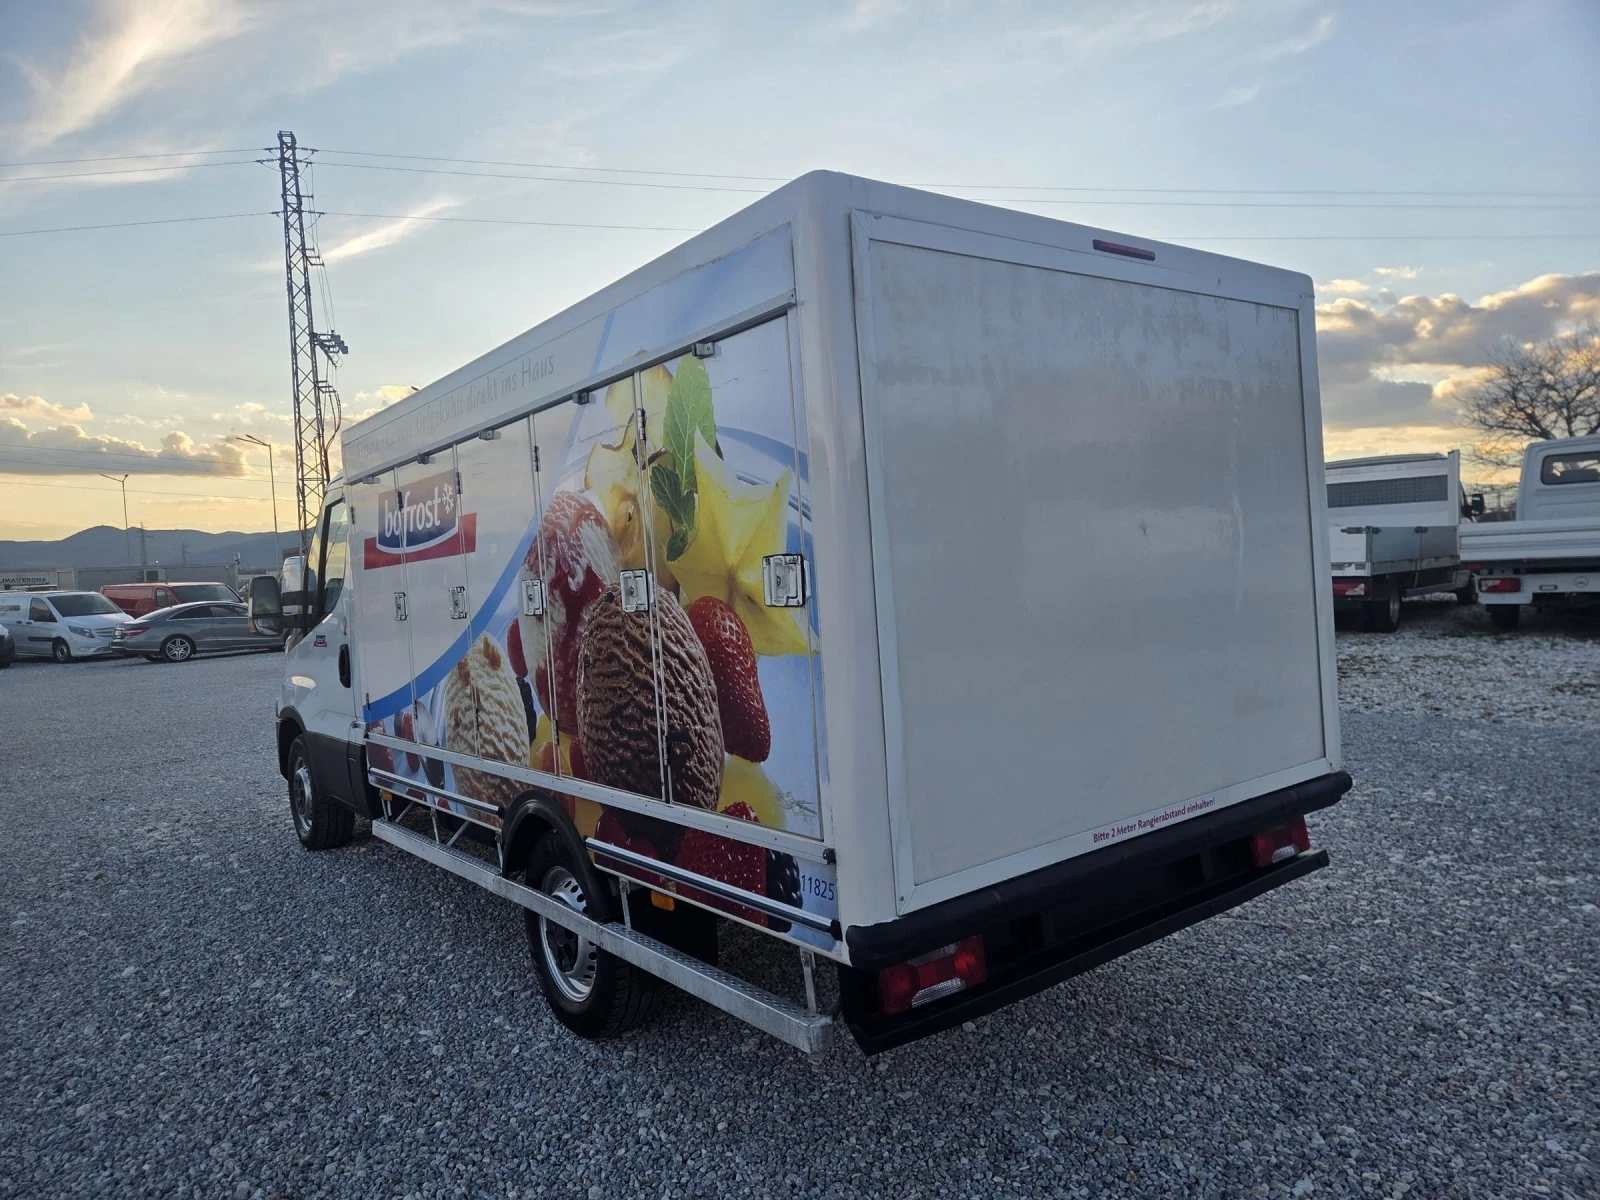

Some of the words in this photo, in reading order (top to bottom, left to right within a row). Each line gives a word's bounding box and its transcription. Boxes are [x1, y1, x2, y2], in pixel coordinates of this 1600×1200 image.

[467, 377, 498, 412] direkt
[501, 372, 517, 396] ins
[521, 354, 555, 388] Haus
[1093, 833, 1109, 843] Bitte
[1111, 828, 1116, 838] 2
[1116, 823, 1137, 836] Meter
[1137, 805, 1186, 829] Rangierabstand
[1187, 797, 1216, 814] einhalten!
[801, 874, 835, 901] 11825
